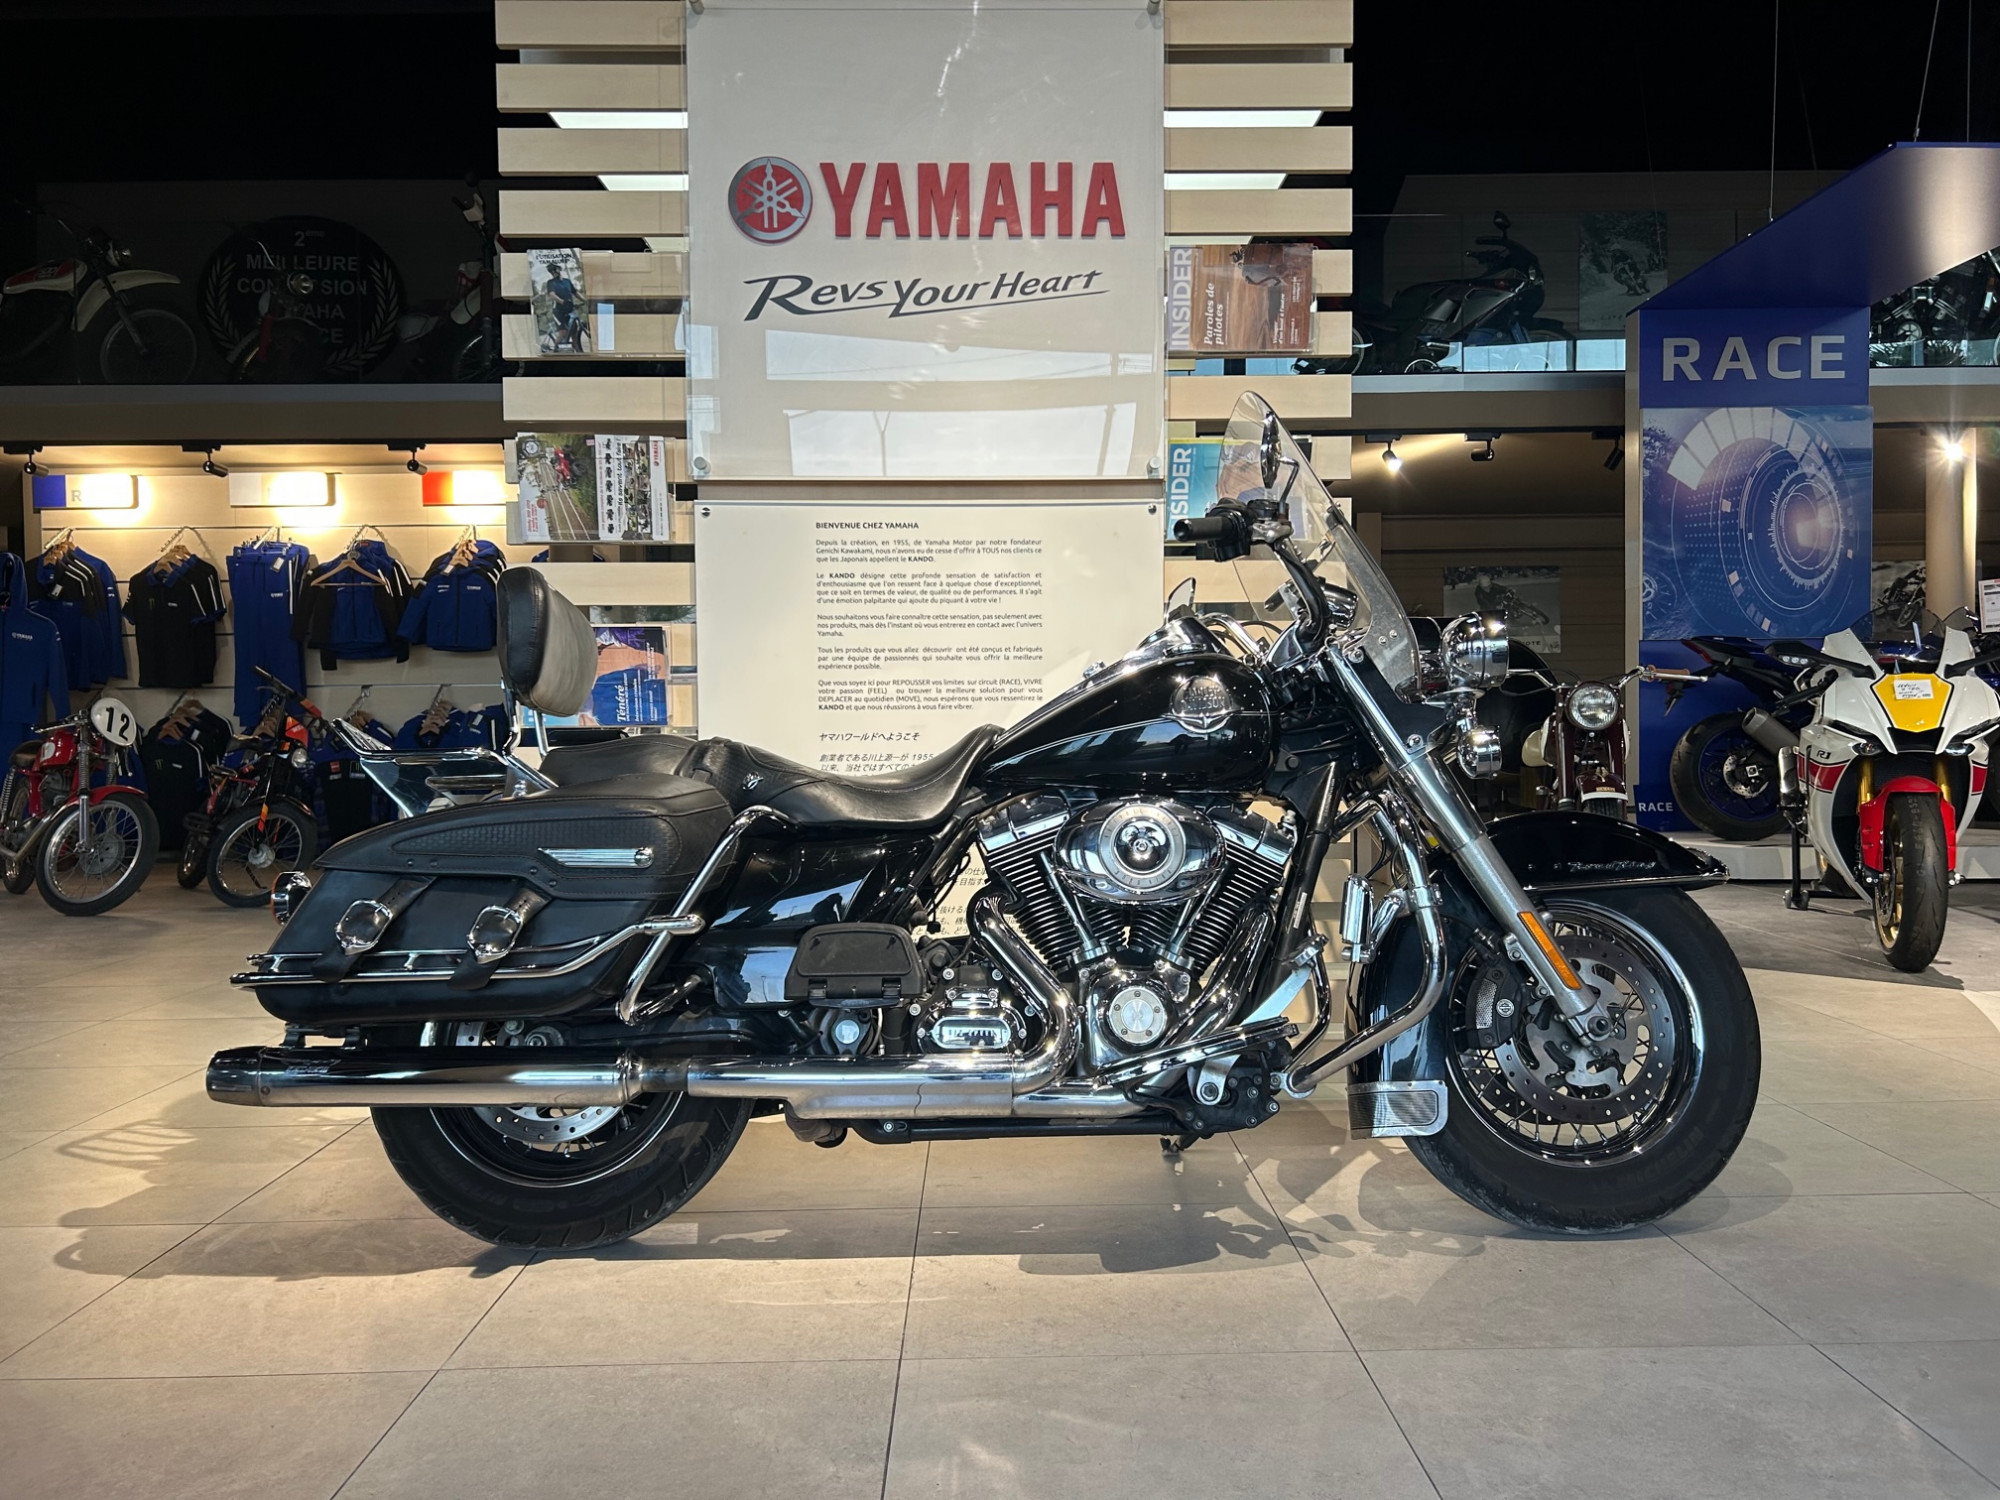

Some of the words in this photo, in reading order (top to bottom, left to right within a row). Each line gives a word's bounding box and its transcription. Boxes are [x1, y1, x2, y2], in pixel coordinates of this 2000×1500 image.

[819, 162, 1126, 238] YAMAHA
[743, 274, 888, 321] Revs
[889, 278, 992, 318] Your
[990, 269, 1104, 300] Heart
[1204, 283, 1214, 298] de
[1170, 247, 1192, 348] INSIDER
[1204, 300, 1214, 345] Paroles
[1213, 304, 1224, 345] pilotes
[1662, 335, 1846, 382] RACE
[1171, 448, 1192, 519] SIDER
[816, 539, 838, 547] Depuis
[840, 556, 868, 564] Japonais
[869, 556, 899, 564] appellent
[911, 572, 941, 580] profonde
[945, 580, 972, 589] quelque
[864, 597, 896, 605] palpitante
[897, 597, 908, 605] qui
[908, 597, 929, 605] ajoute
[939, 597, 964, 605] piquant
[845, 646, 872, 654] produits
[922, 654, 932, 662] qui
[839, 687, 864, 695] passion
[614, 685, 626, 722] Ténéré
[863, 695, 894, 703] quotidien
[105, 706, 131, 742] 12
[819, 732, 920, 741] ヤマハワールドへようこそ
[1816, 750, 1831, 759] R1
[1638, 802, 1673, 812] RACE
